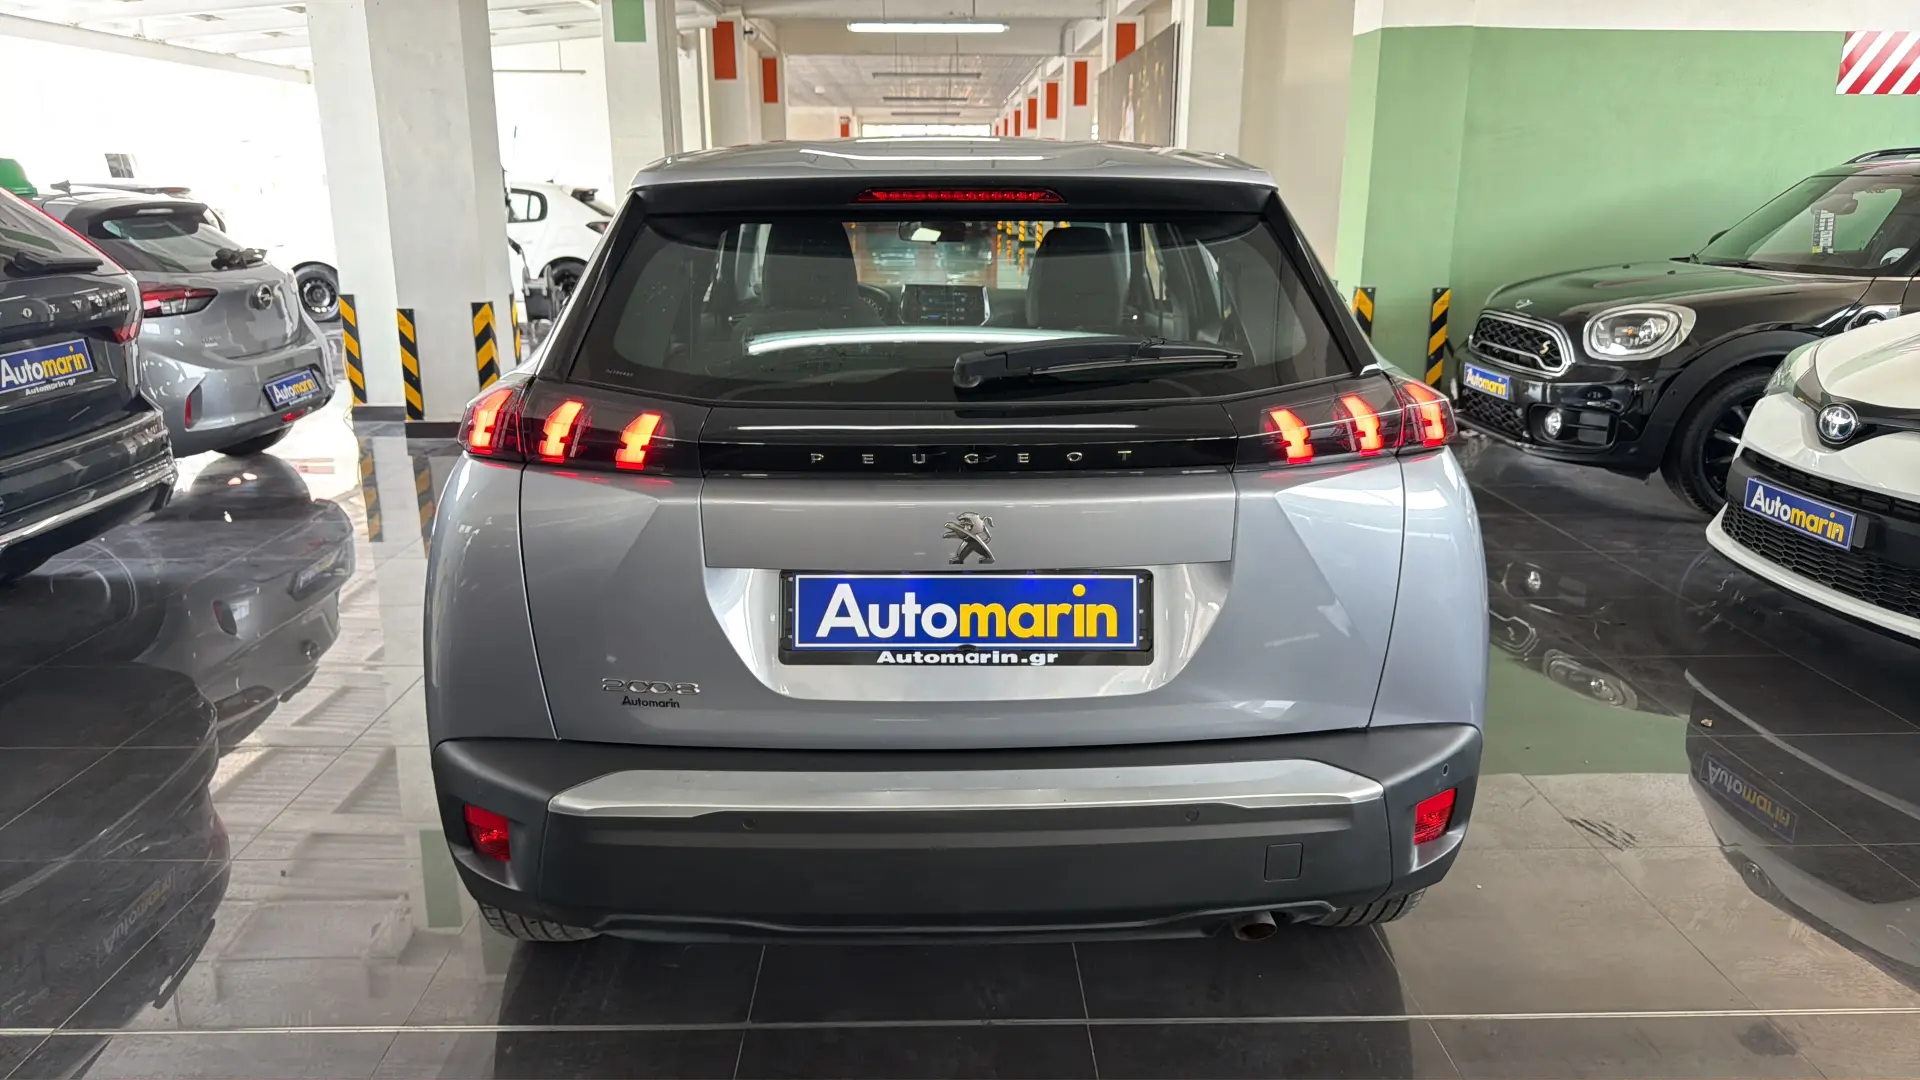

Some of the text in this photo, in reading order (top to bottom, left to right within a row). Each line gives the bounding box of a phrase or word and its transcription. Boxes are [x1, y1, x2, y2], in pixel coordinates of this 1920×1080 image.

[0, 345, 88, 388] Automarin
[25, 378, 76, 396] Automarin.gr
[273, 374, 316, 402] Automarin
[1466, 368, 1507, 396] Automarin
[810, 450, 1132, 465] PEUGEOT
[1750, 485, 1845, 542] Automarin
[815, 583, 1118, 638] Automarin
[876, 650, 1059, 666] Automarin.gr
[602, 678, 701, 695] 2008
[621, 695, 681, 708] Automarin
